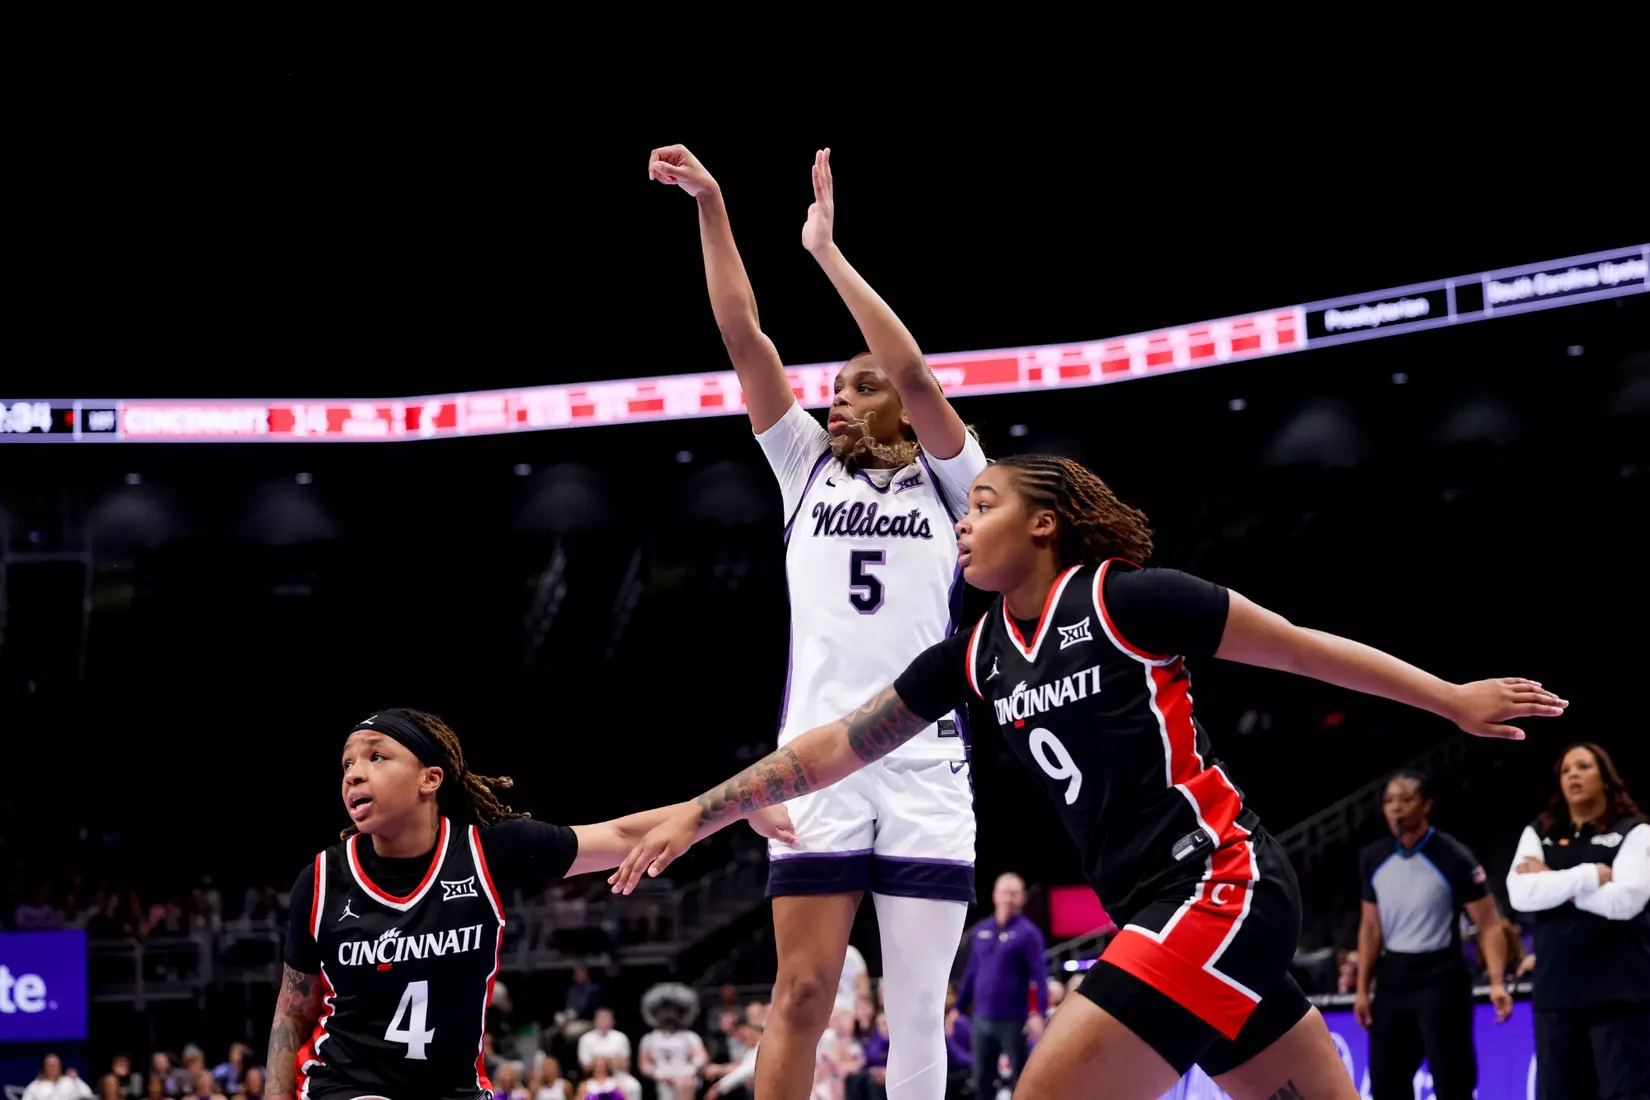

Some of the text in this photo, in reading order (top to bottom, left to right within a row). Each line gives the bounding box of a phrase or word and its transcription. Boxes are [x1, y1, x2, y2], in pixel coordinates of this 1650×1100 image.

[812, 500, 933, 539] Wildcats
[849, 549, 886, 615] 5
[1029, 727, 1083, 805] 9
[338, 924, 483, 966] CINCINNATI
[384, 980, 436, 1060] 4
